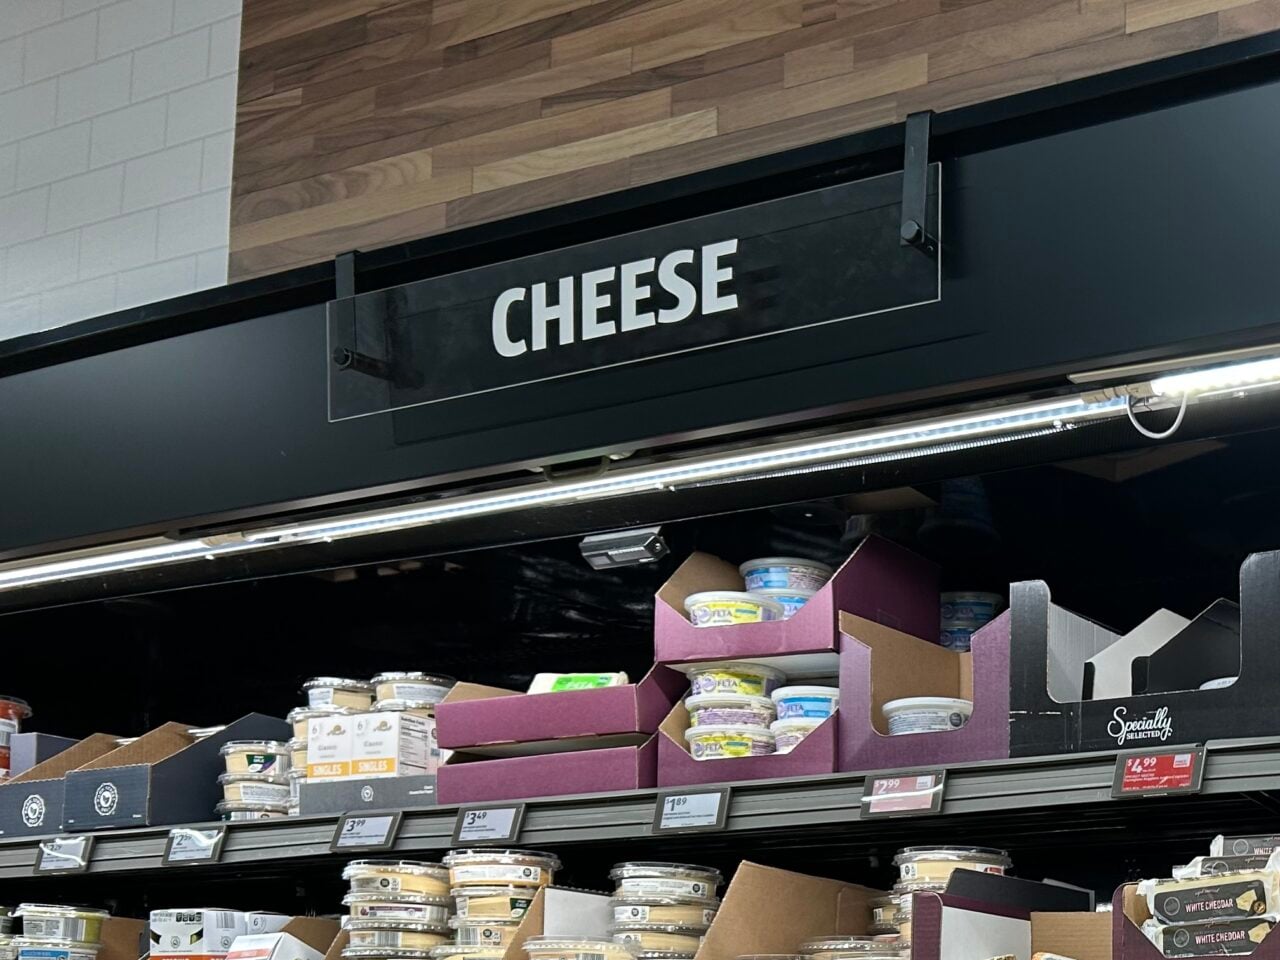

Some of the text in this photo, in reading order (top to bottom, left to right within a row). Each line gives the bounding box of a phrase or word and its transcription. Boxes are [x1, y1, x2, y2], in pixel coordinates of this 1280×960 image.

[492, 238, 738, 357] CHEESE
[1185, 898, 1233, 913] WHITE CHEDDAR
[1195, 931, 1245, 944] WHITE CHEDDAR
